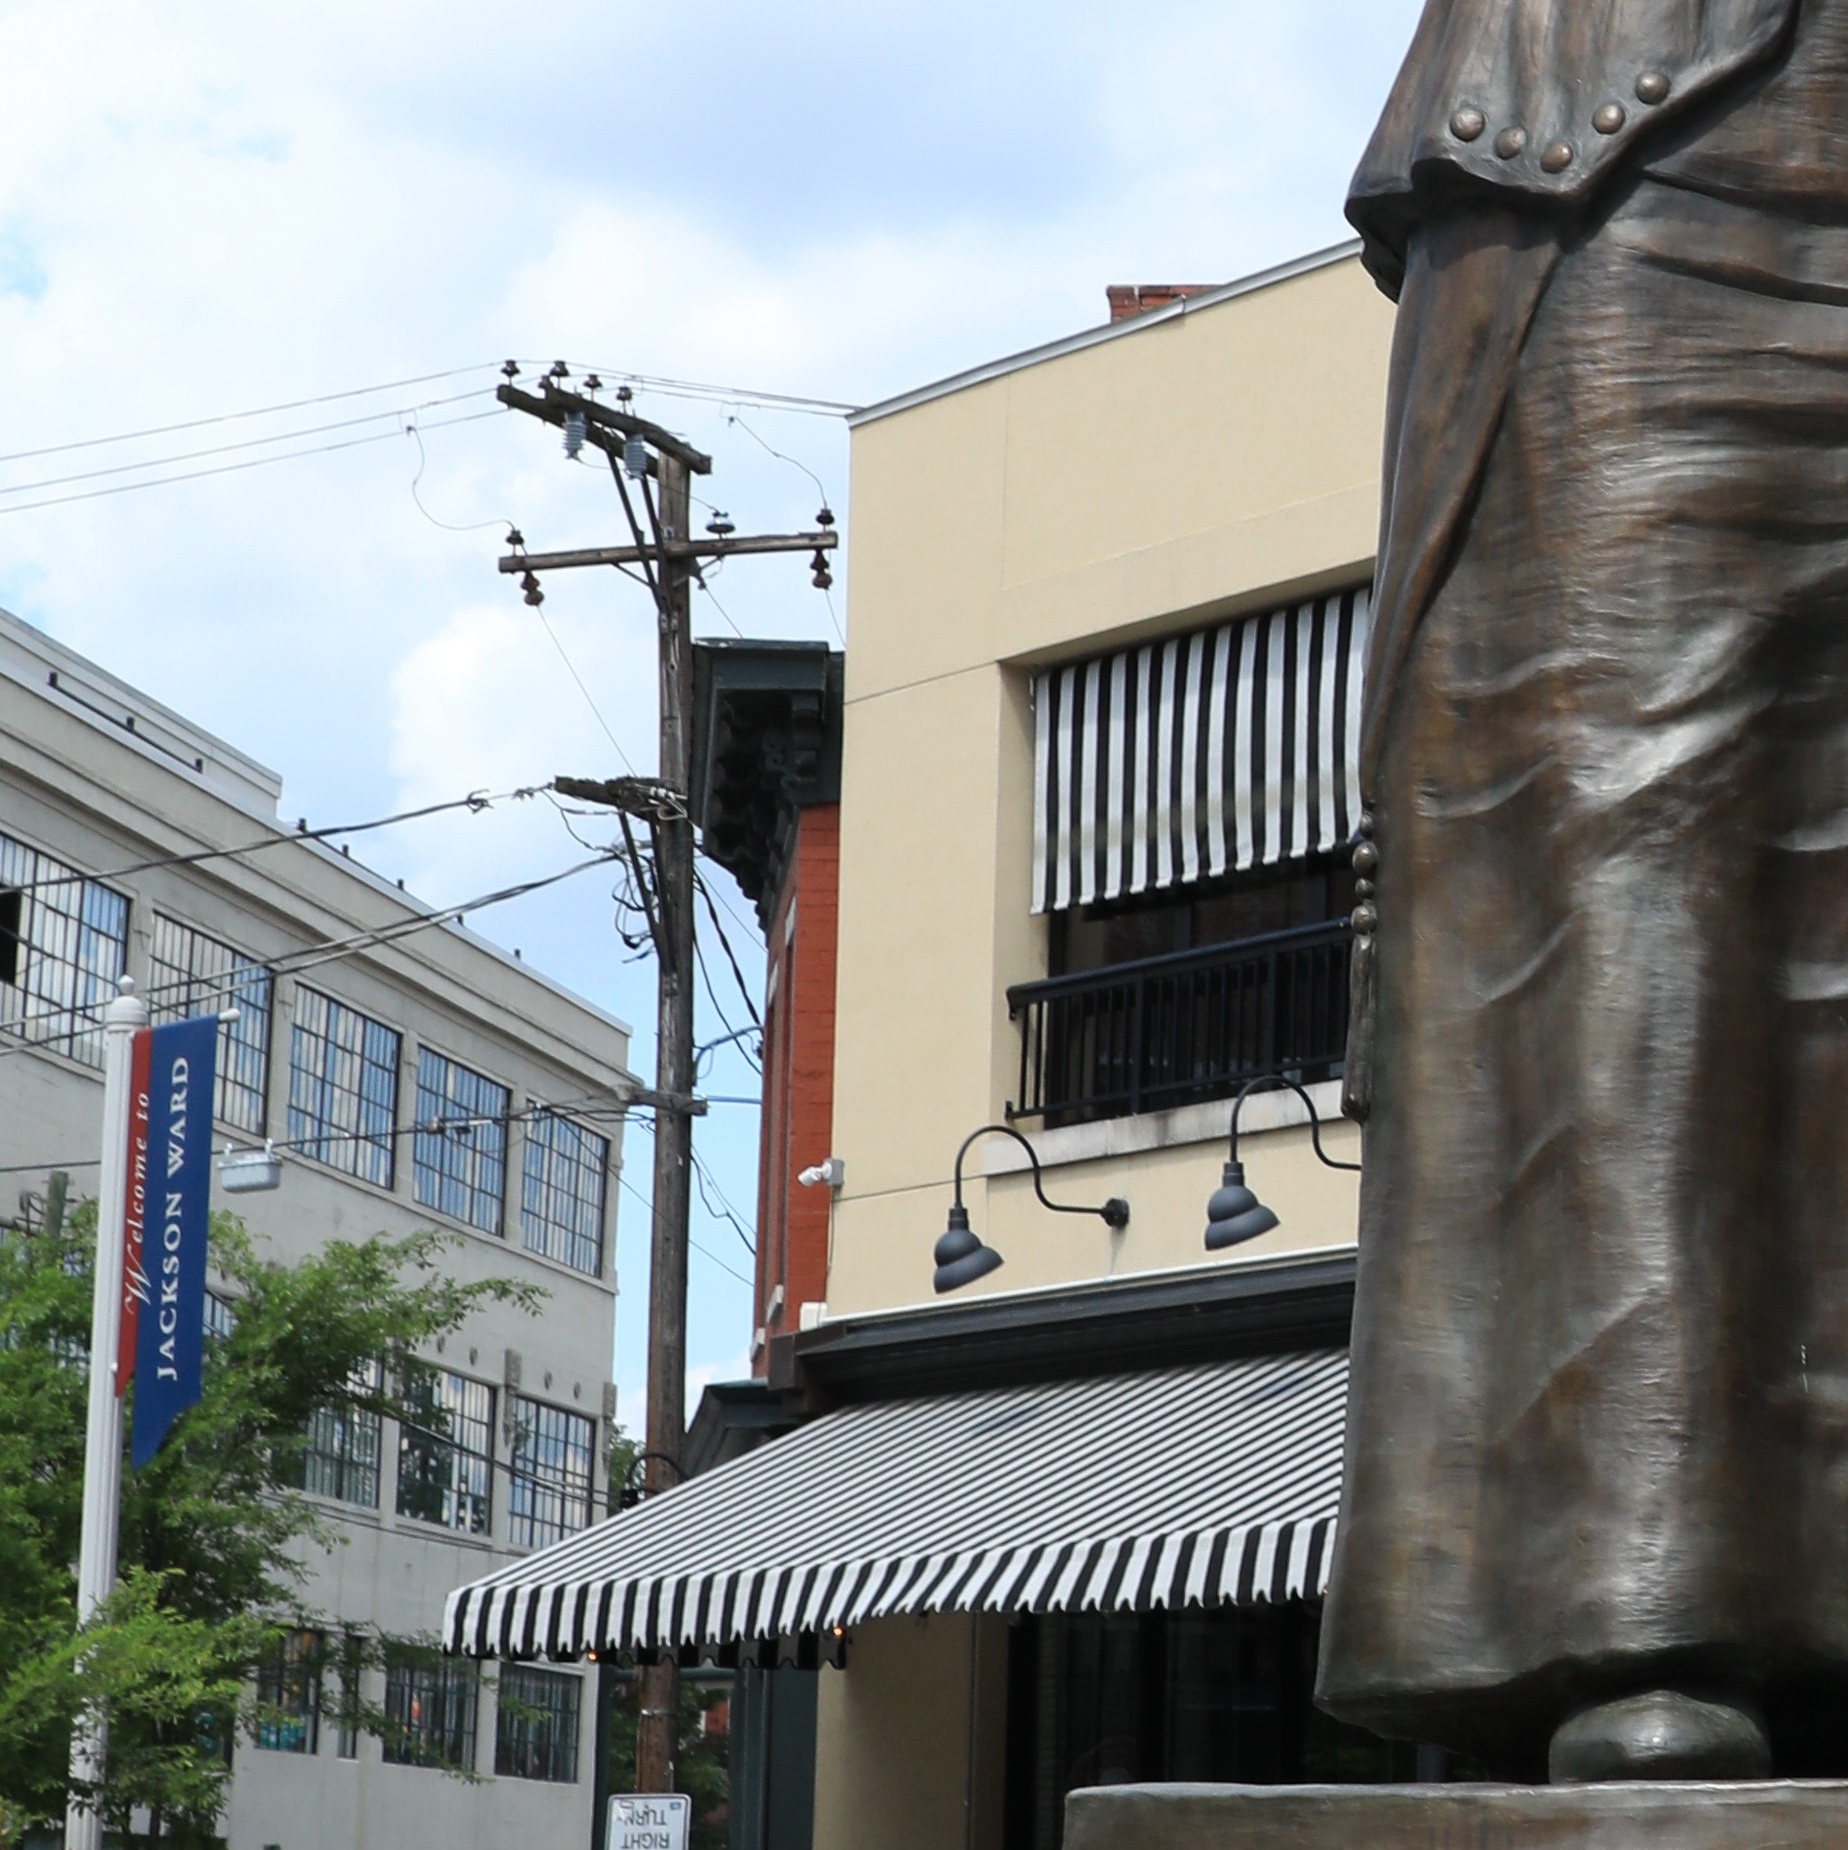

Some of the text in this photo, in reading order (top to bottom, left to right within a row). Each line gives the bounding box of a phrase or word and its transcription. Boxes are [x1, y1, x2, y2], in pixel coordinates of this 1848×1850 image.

[124, 1092, 152, 1315] Welcome to
[157, 1057, 189, 1381] JACKSON WARD
[621, 1832, 670, 1849] RIGHT
